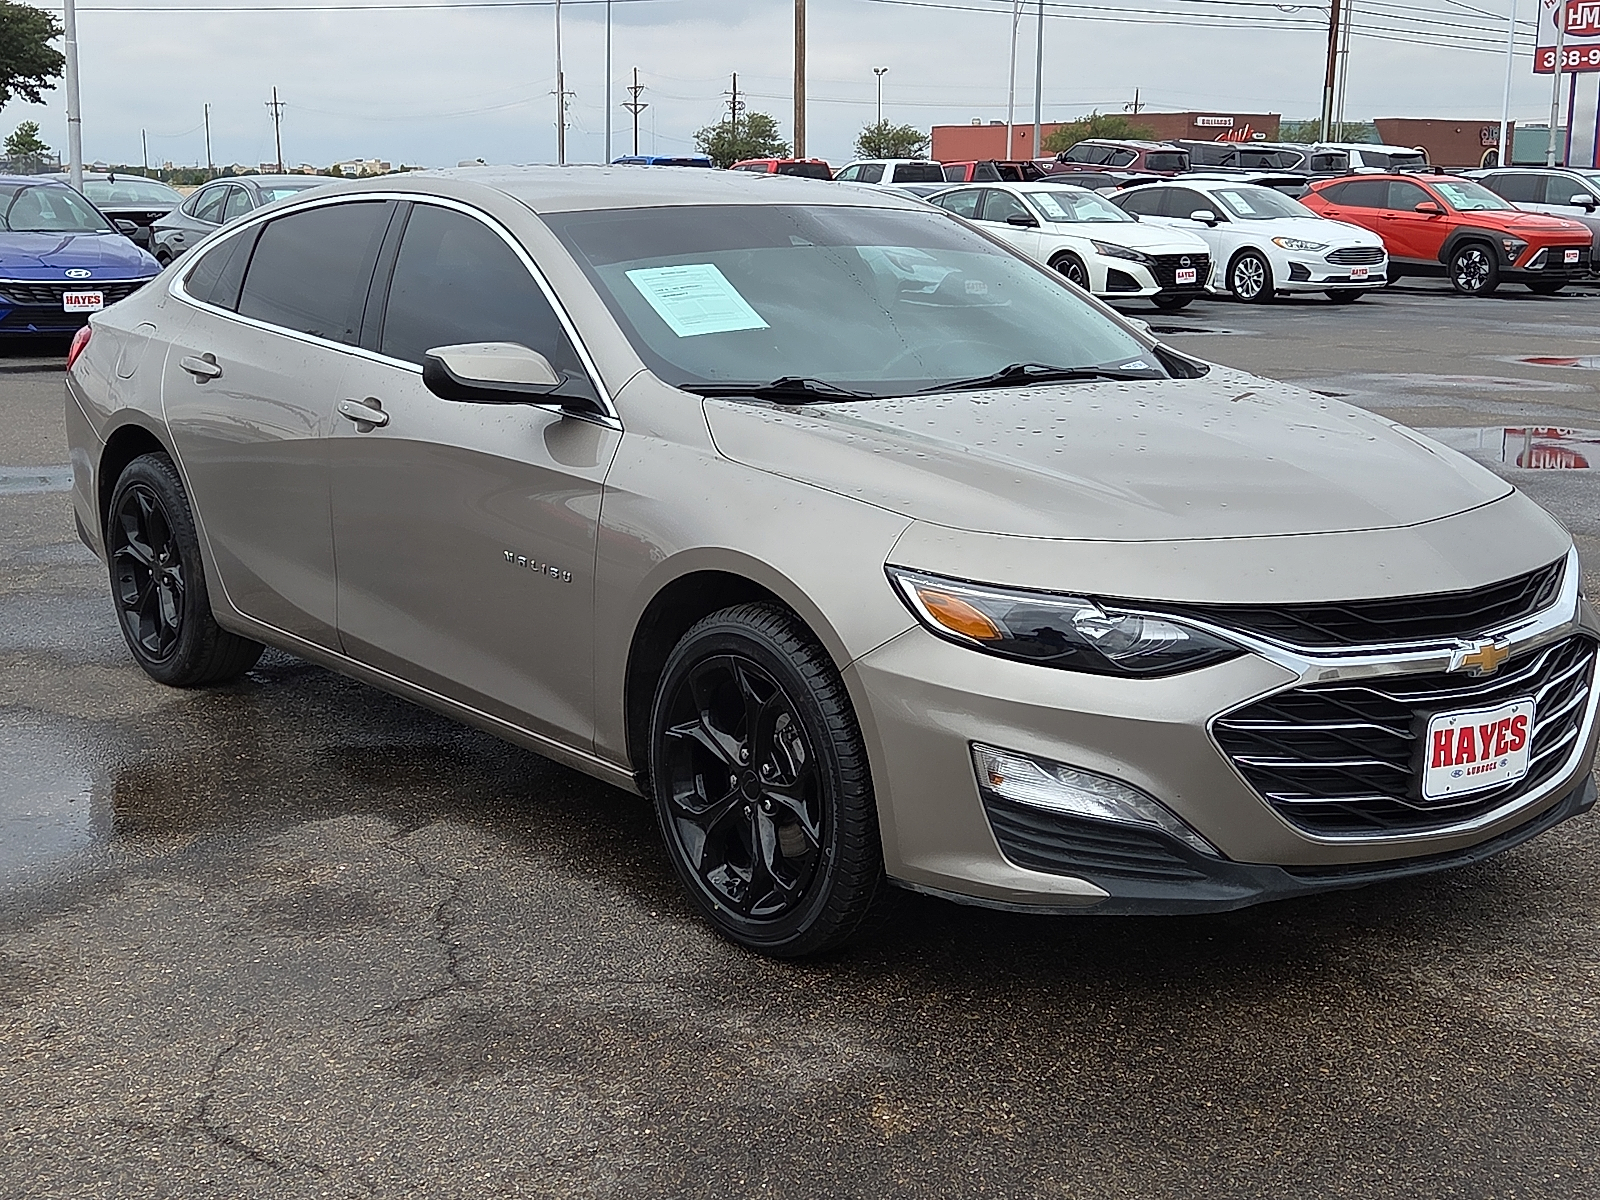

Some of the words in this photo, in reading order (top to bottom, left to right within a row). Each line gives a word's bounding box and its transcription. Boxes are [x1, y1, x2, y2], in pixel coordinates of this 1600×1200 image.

[65, 295, 101, 305] HAYES
[503, 549, 573, 583] MALIBU
[1431, 714, 1528, 769] HAYES
[1466, 761, 1498, 776] LUBBOCK
